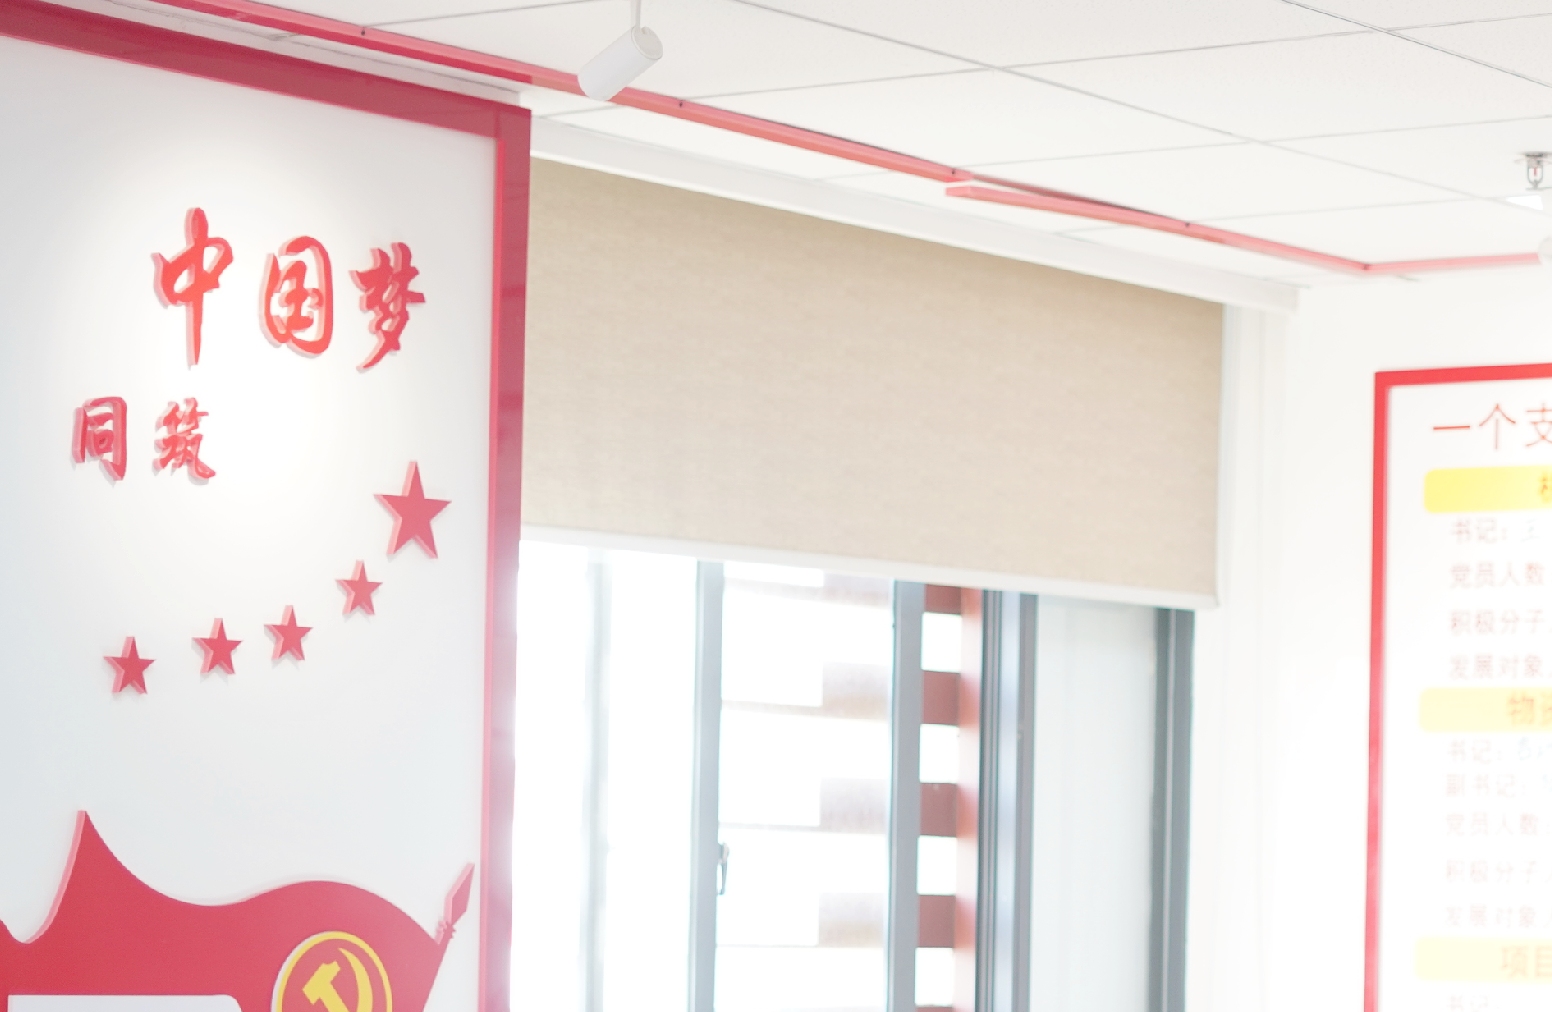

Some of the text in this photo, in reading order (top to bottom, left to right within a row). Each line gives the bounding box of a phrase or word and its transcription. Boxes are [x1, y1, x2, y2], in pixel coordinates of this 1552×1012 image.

[152, 207, 426, 372] 中国梦
[72, 395, 216, 483] 同筑
